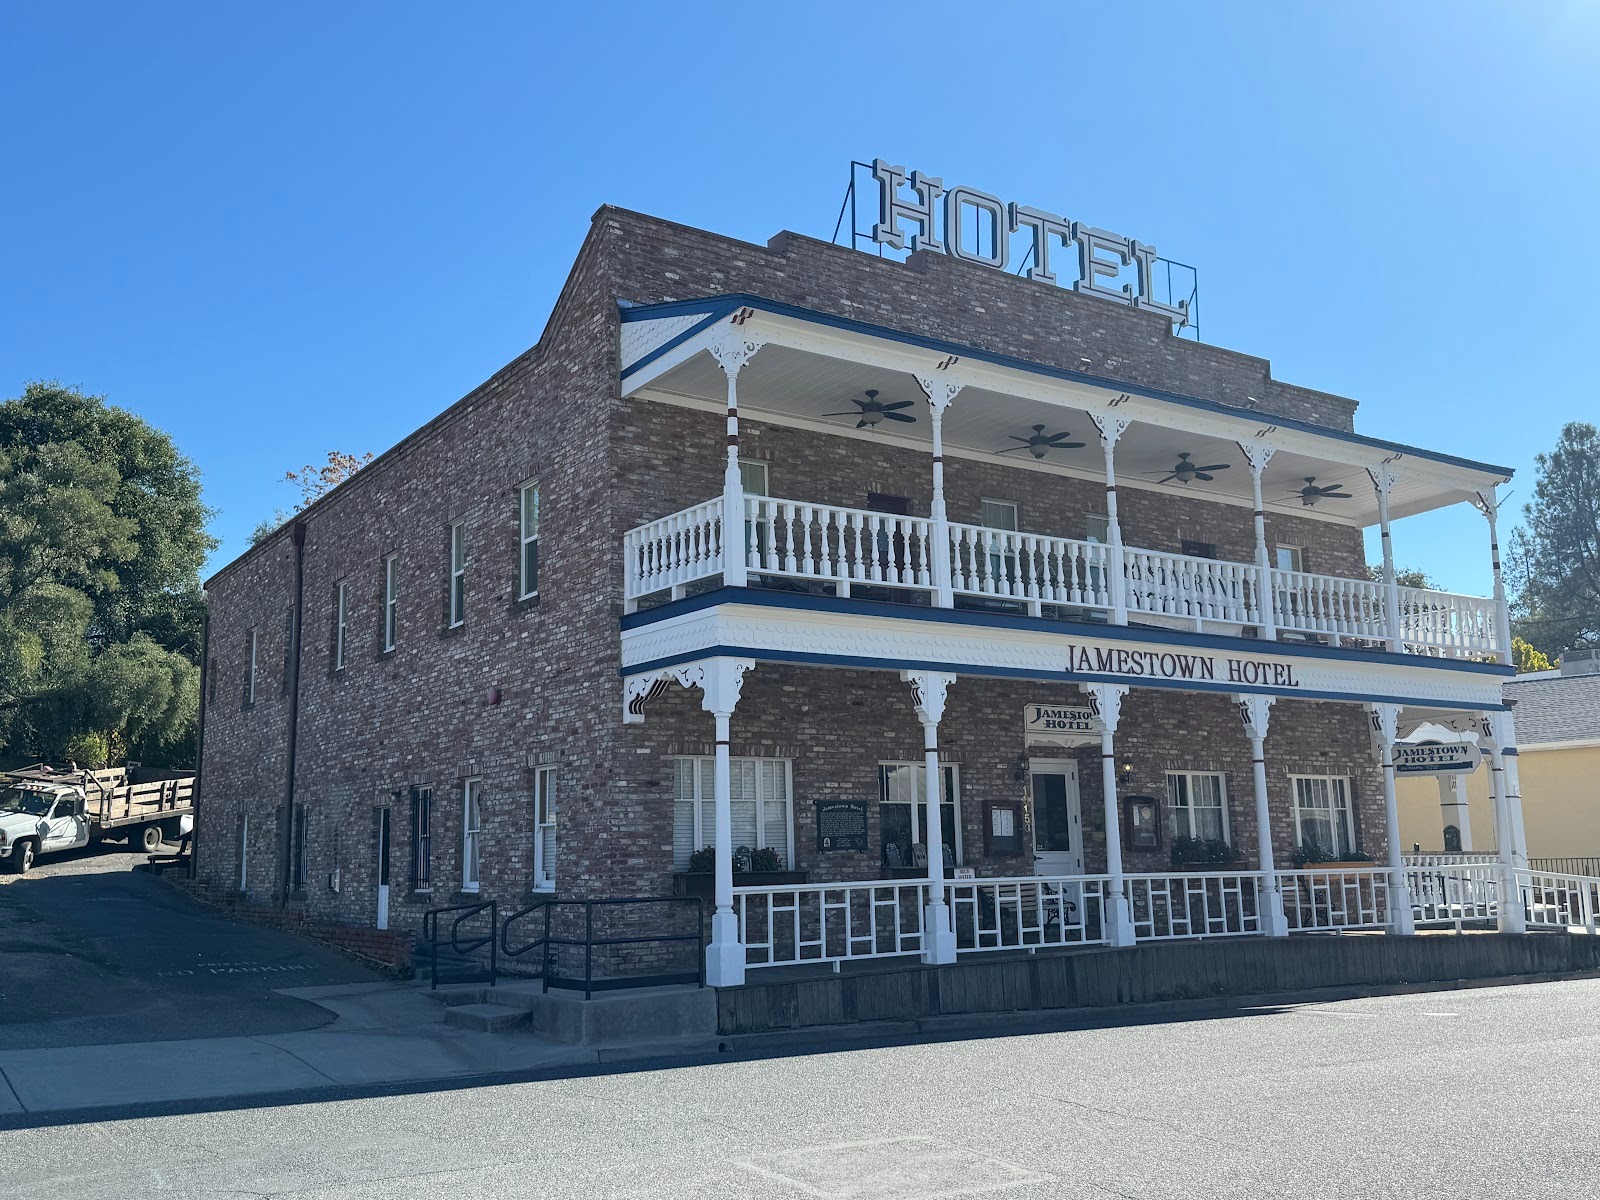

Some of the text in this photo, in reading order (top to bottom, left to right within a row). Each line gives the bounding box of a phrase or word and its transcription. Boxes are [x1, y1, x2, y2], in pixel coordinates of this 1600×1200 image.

[872, 158, 1189, 328] HOTEL
[1065, 644, 1299, 687] JAMESTOWN HOTEL
[1030, 707, 1093, 725] JAMESTO
[1043, 719, 1093, 730] HOTEL
[1392, 745, 1468, 762] JAMESTOWN
[1403, 754, 1460, 764] HOTEL
